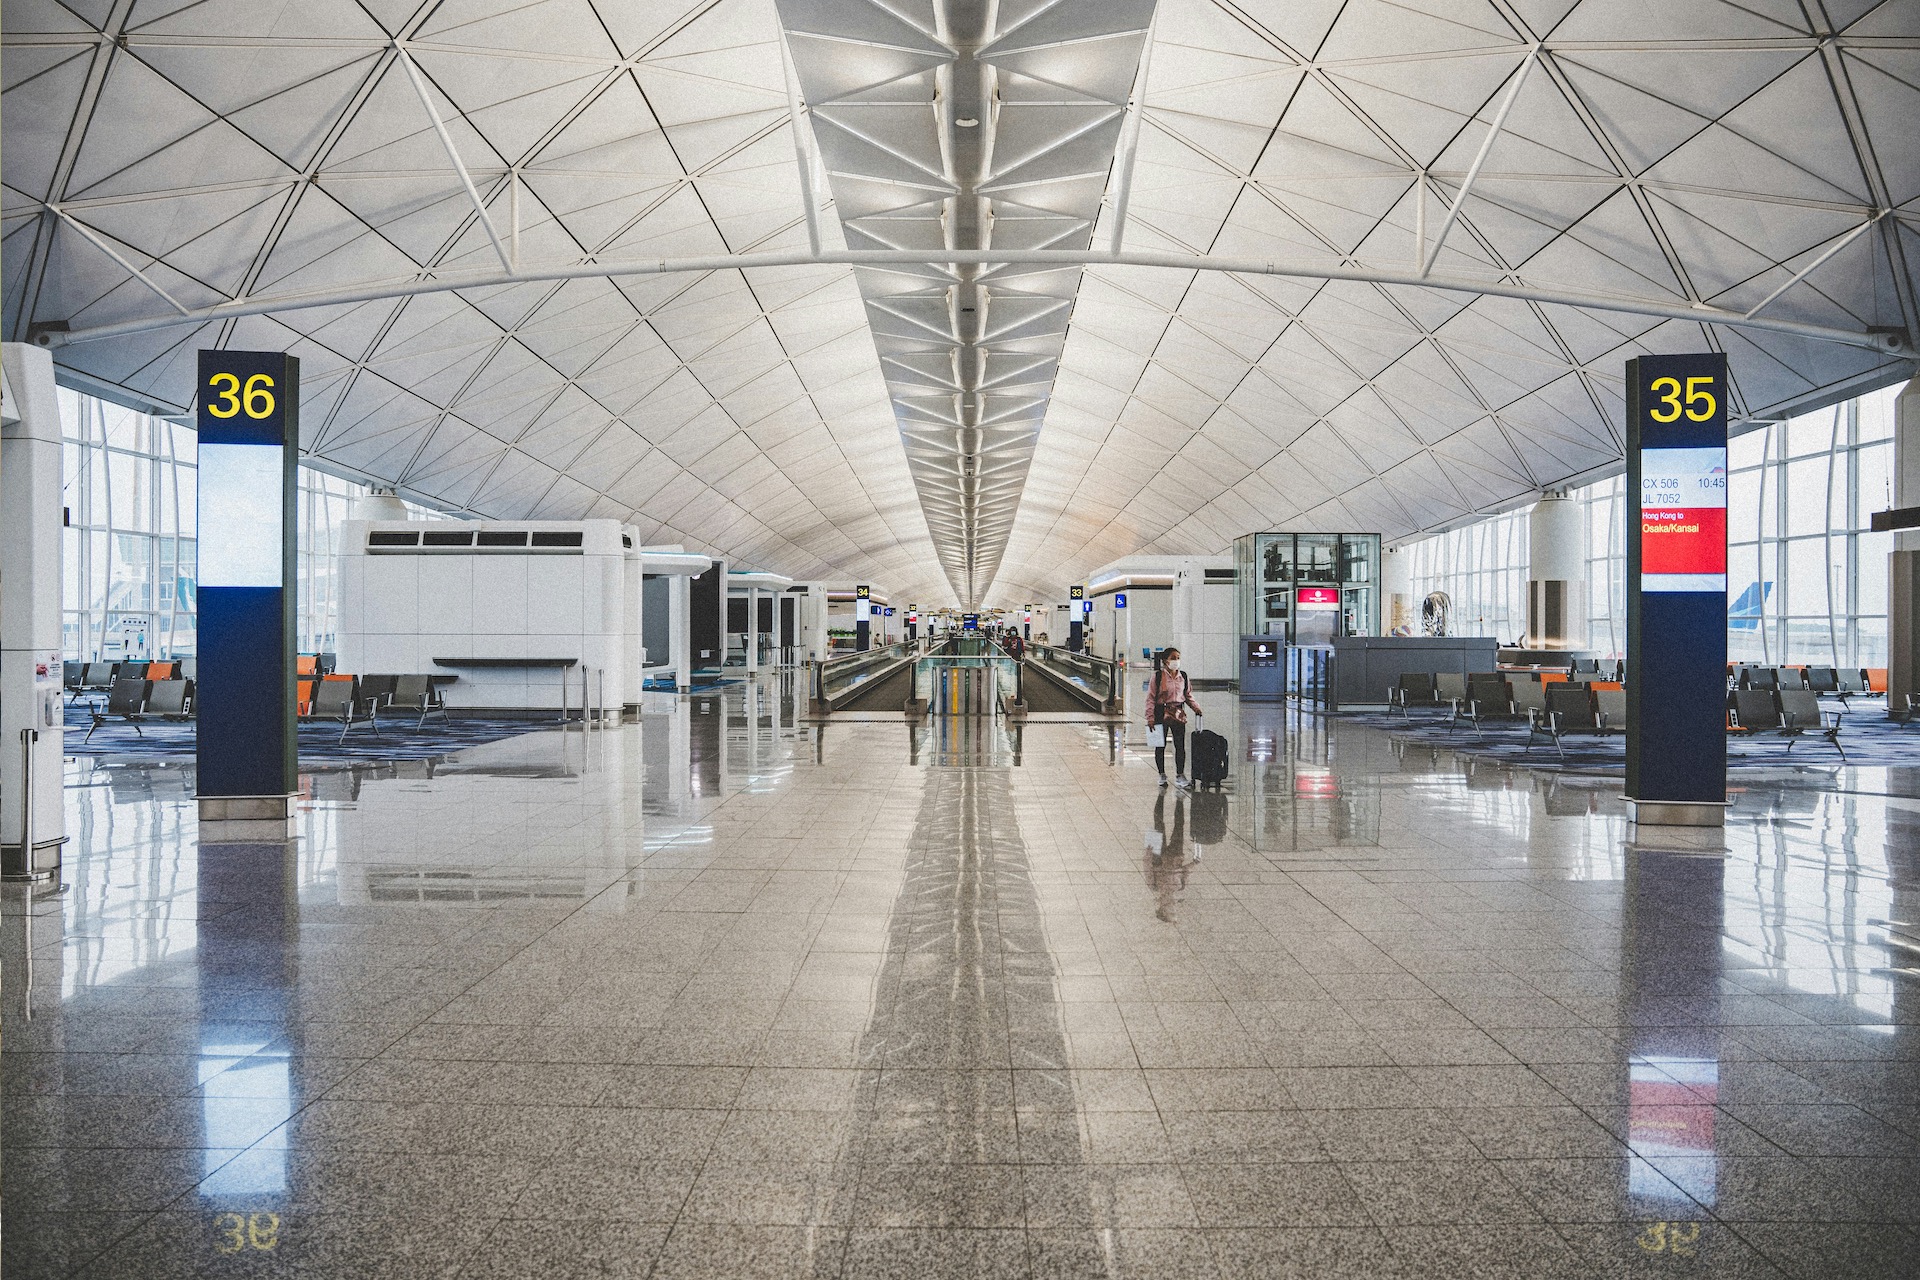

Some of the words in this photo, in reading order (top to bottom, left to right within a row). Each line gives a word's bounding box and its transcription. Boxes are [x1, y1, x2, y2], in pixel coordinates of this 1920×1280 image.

[208, 373, 275, 420] 36
[1650, 376, 1717, 423] 35
[1642, 478, 1658, 489] CX
[1660, 478, 1679, 489] 506
[1699, 477, 1725, 488] 10:45
[1642, 494, 1654, 504] JL
[1657, 494, 1681, 504] 7052
[1642, 512, 1659, 521] Hong
[1660, 512, 1676, 521] Kong
[1642, 523, 1700, 533] Osaka/Kansai
[858, 588, 868, 596] 34
[1072, 589, 1082, 597] 33
